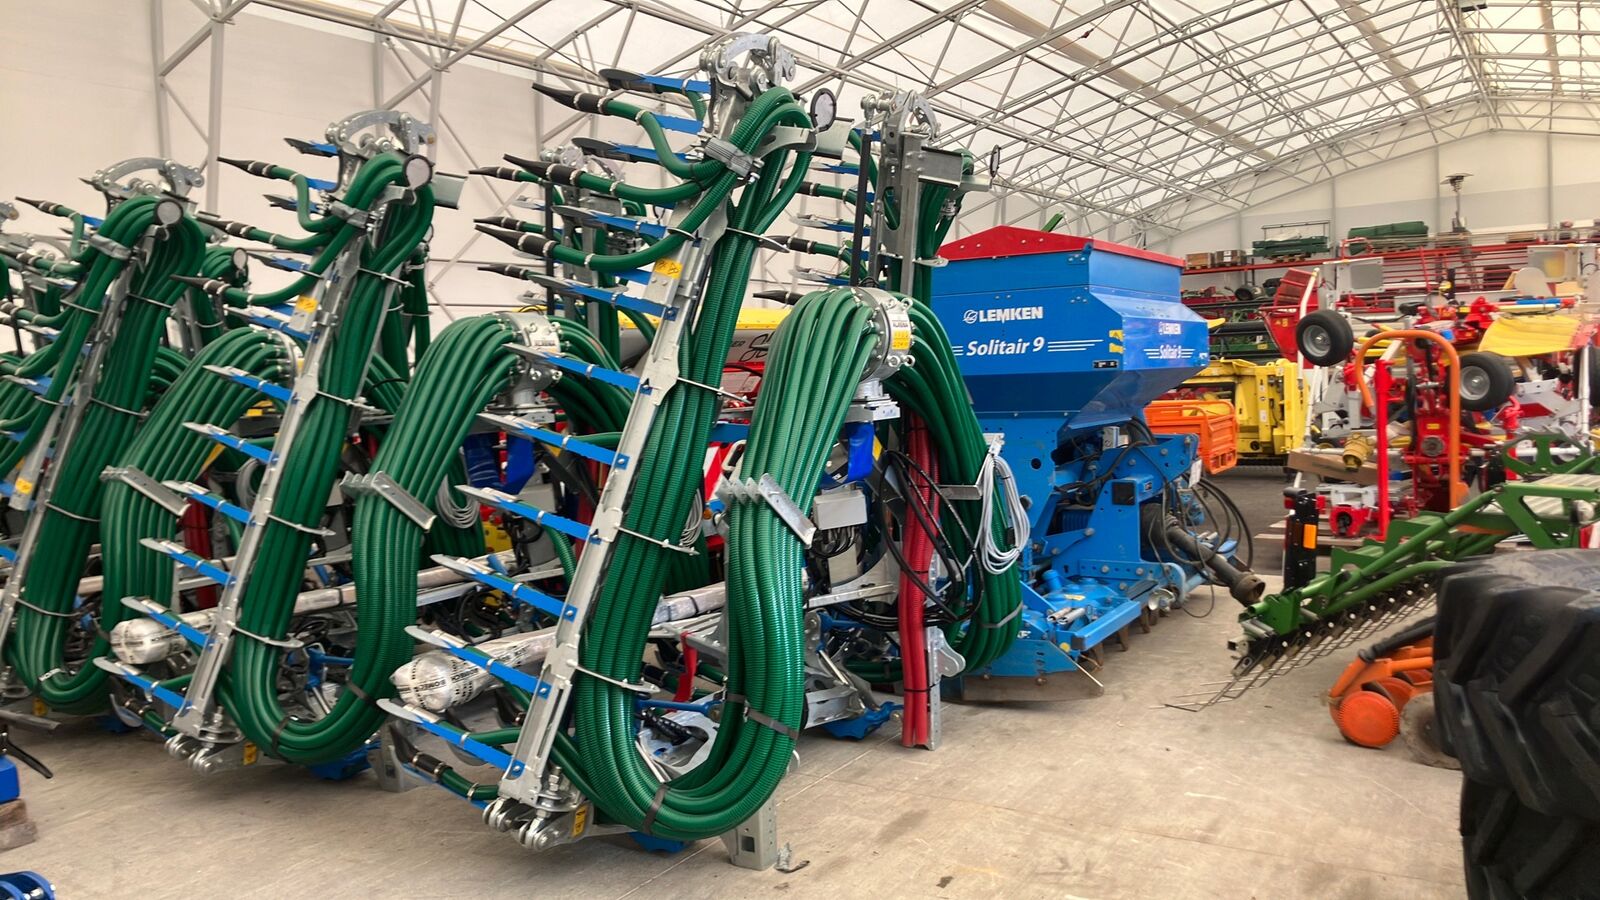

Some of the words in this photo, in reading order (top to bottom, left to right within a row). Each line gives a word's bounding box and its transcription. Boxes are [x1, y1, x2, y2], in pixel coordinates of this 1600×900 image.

[979, 307, 1044, 323] LEMKEN
[966, 338, 1030, 357] Solitair
[1032, 336, 1045, 352] 9
